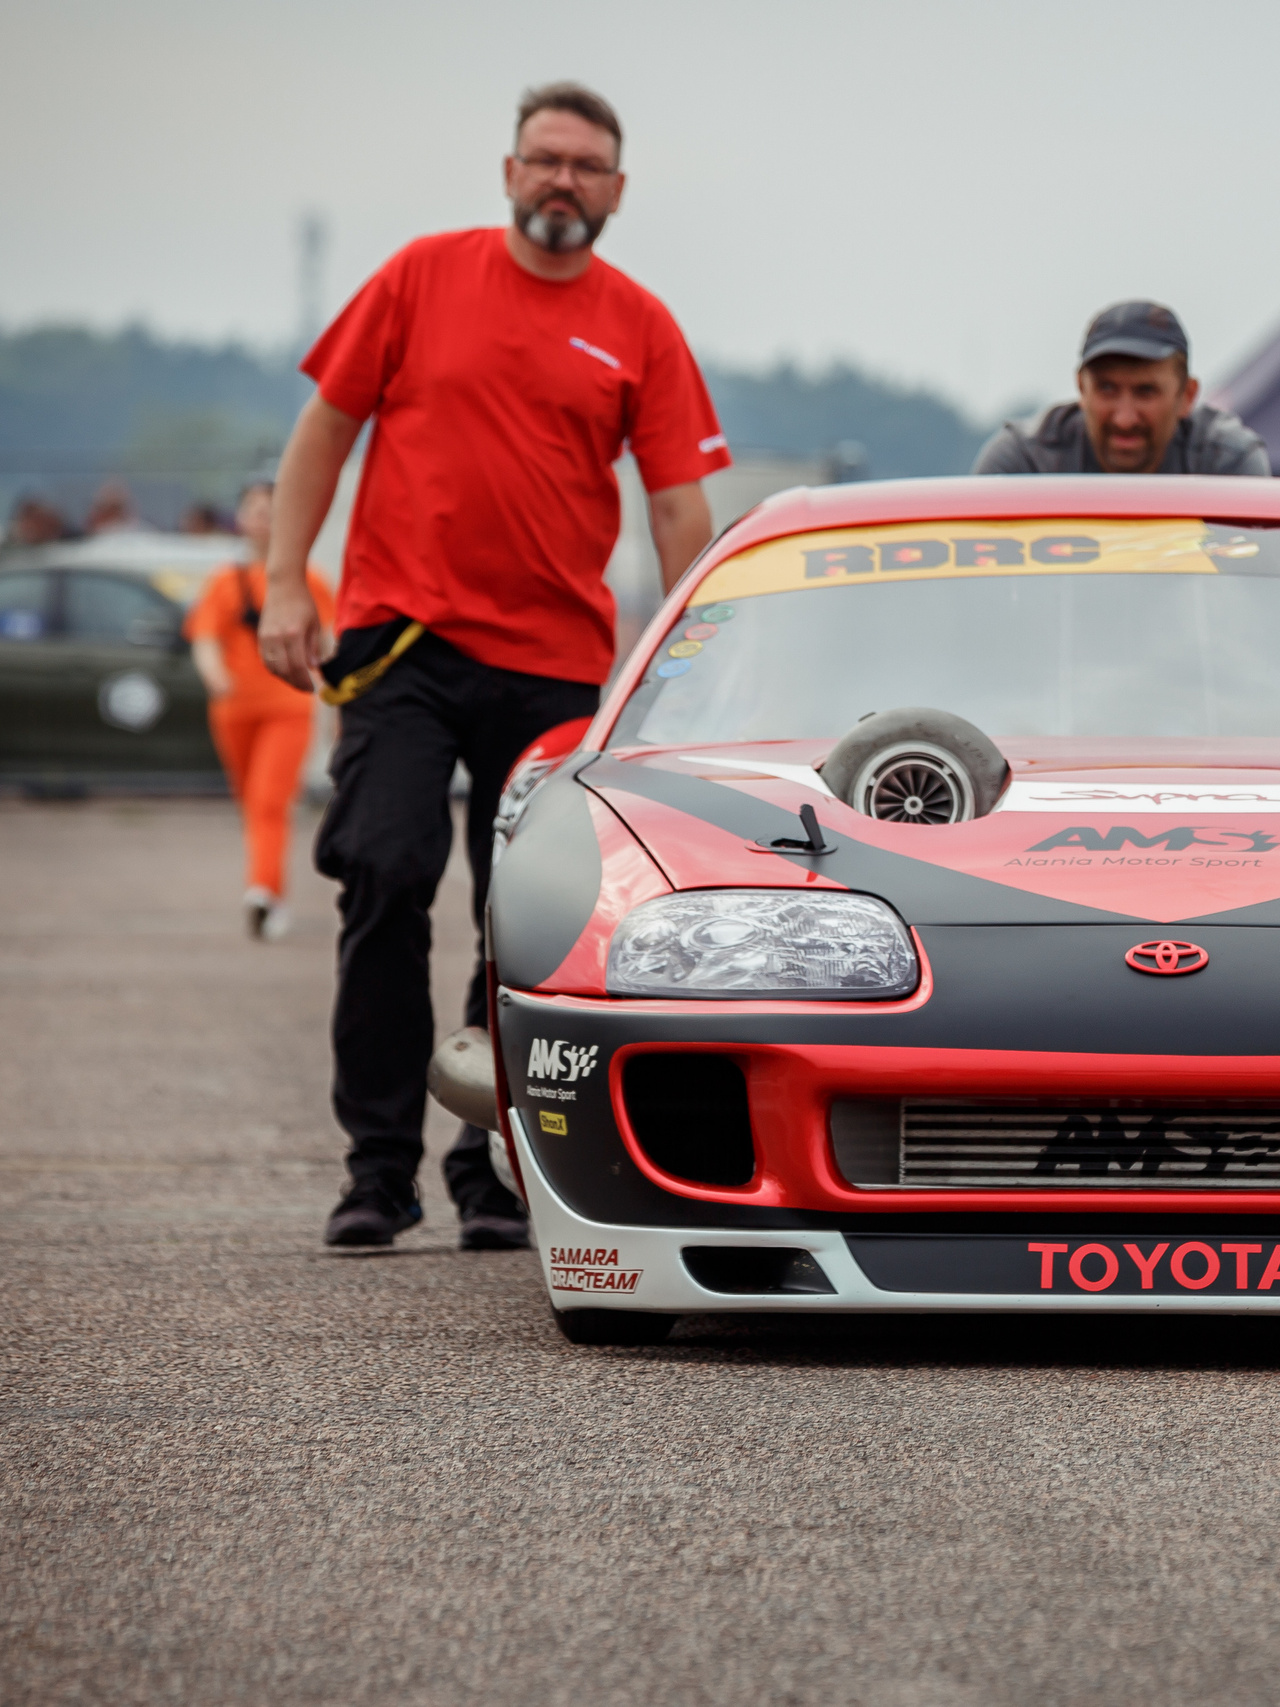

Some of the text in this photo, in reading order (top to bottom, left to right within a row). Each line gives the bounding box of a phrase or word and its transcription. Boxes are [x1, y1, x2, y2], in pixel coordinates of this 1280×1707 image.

[801, 536, 1100, 579] RDRC
[1003, 856, 1264, 868] Alania Motor Sport
[557, 1088, 577, 1102] Sport
[550, 1247, 618, 1266] SAMARA
